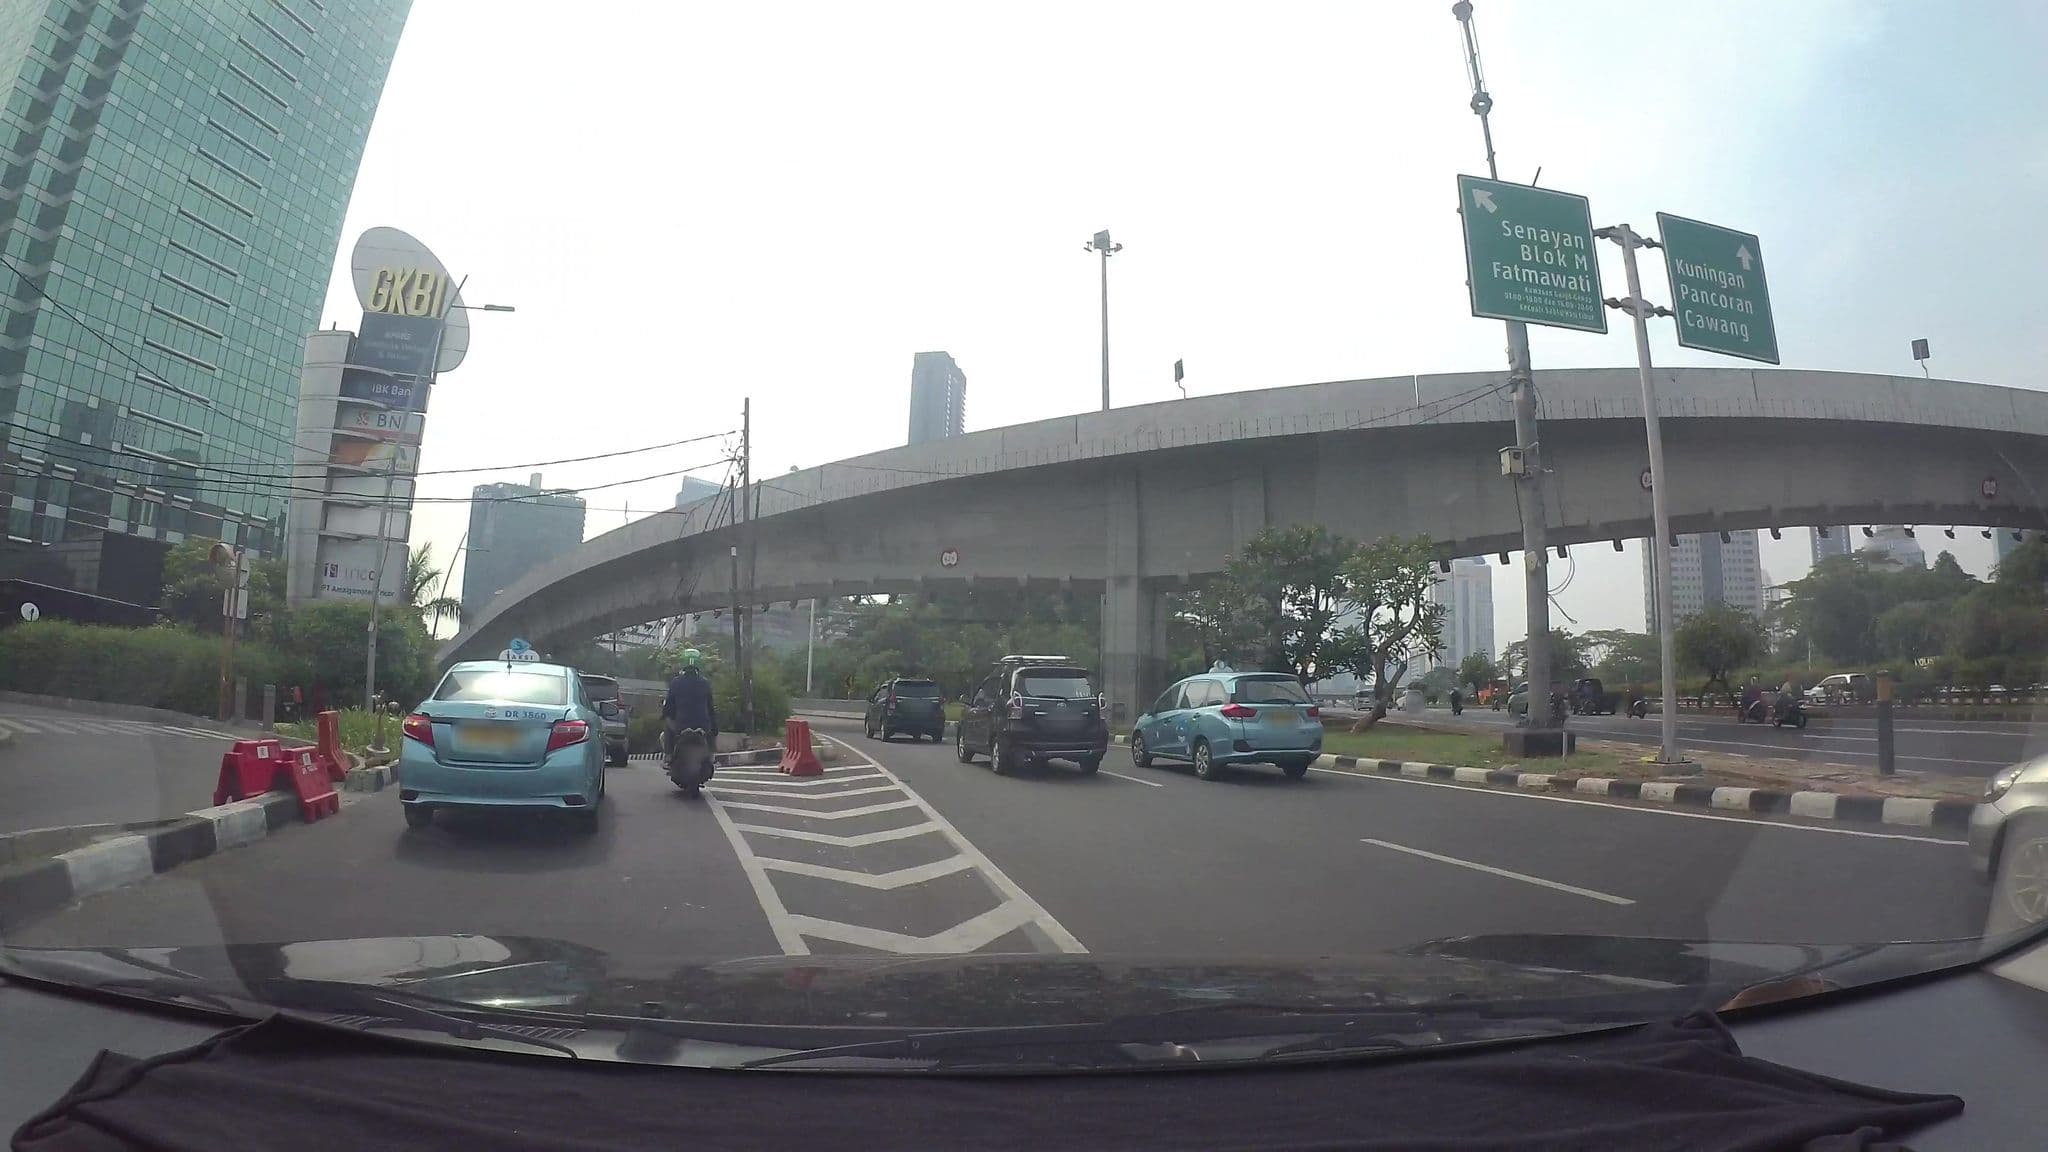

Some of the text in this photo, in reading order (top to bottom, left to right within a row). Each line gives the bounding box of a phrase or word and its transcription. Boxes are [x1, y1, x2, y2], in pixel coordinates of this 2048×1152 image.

[1502, 220, 1584, 249] Senayan
[1521, 244, 1588, 271] Blok M
[1492, 262, 1591, 293] Fatmawati
[1675, 258, 1745, 289] Kuningan
[366, 266, 448, 319] GKBI
[1680, 284, 1753, 314] Pancoran
[1684, 309, 1749, 342] Cawang
[372, 383, 414, 397] IBK Ban
[377, 413, 404, 429] BN
[505, 710, 519, 718] DR
